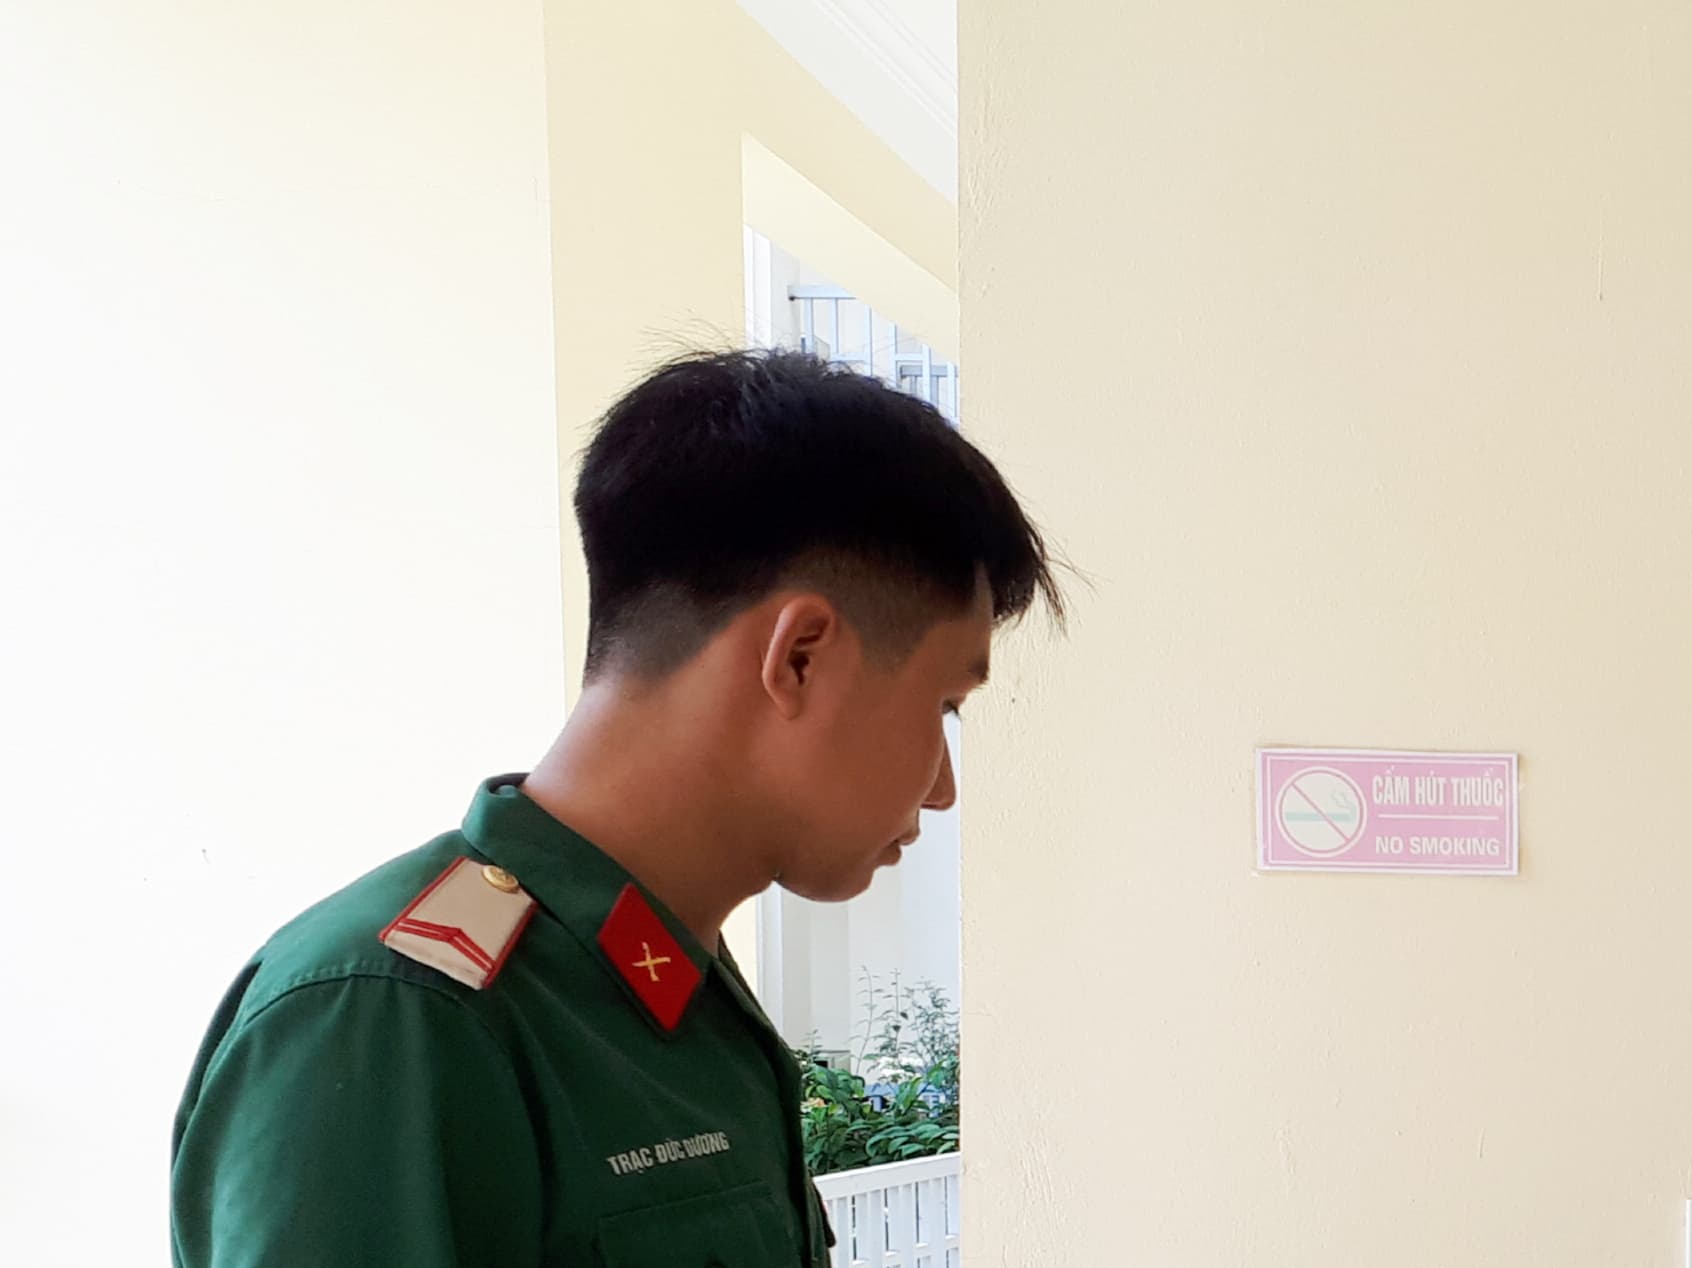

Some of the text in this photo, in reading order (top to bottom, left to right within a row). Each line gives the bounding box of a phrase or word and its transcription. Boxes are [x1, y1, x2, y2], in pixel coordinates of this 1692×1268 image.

[1372, 764, 1505, 808] CẤM HÚT THUỐC
[1376, 836, 1501, 857] NO SMOKING
[607, 1147, 655, 1175] TRẠC
